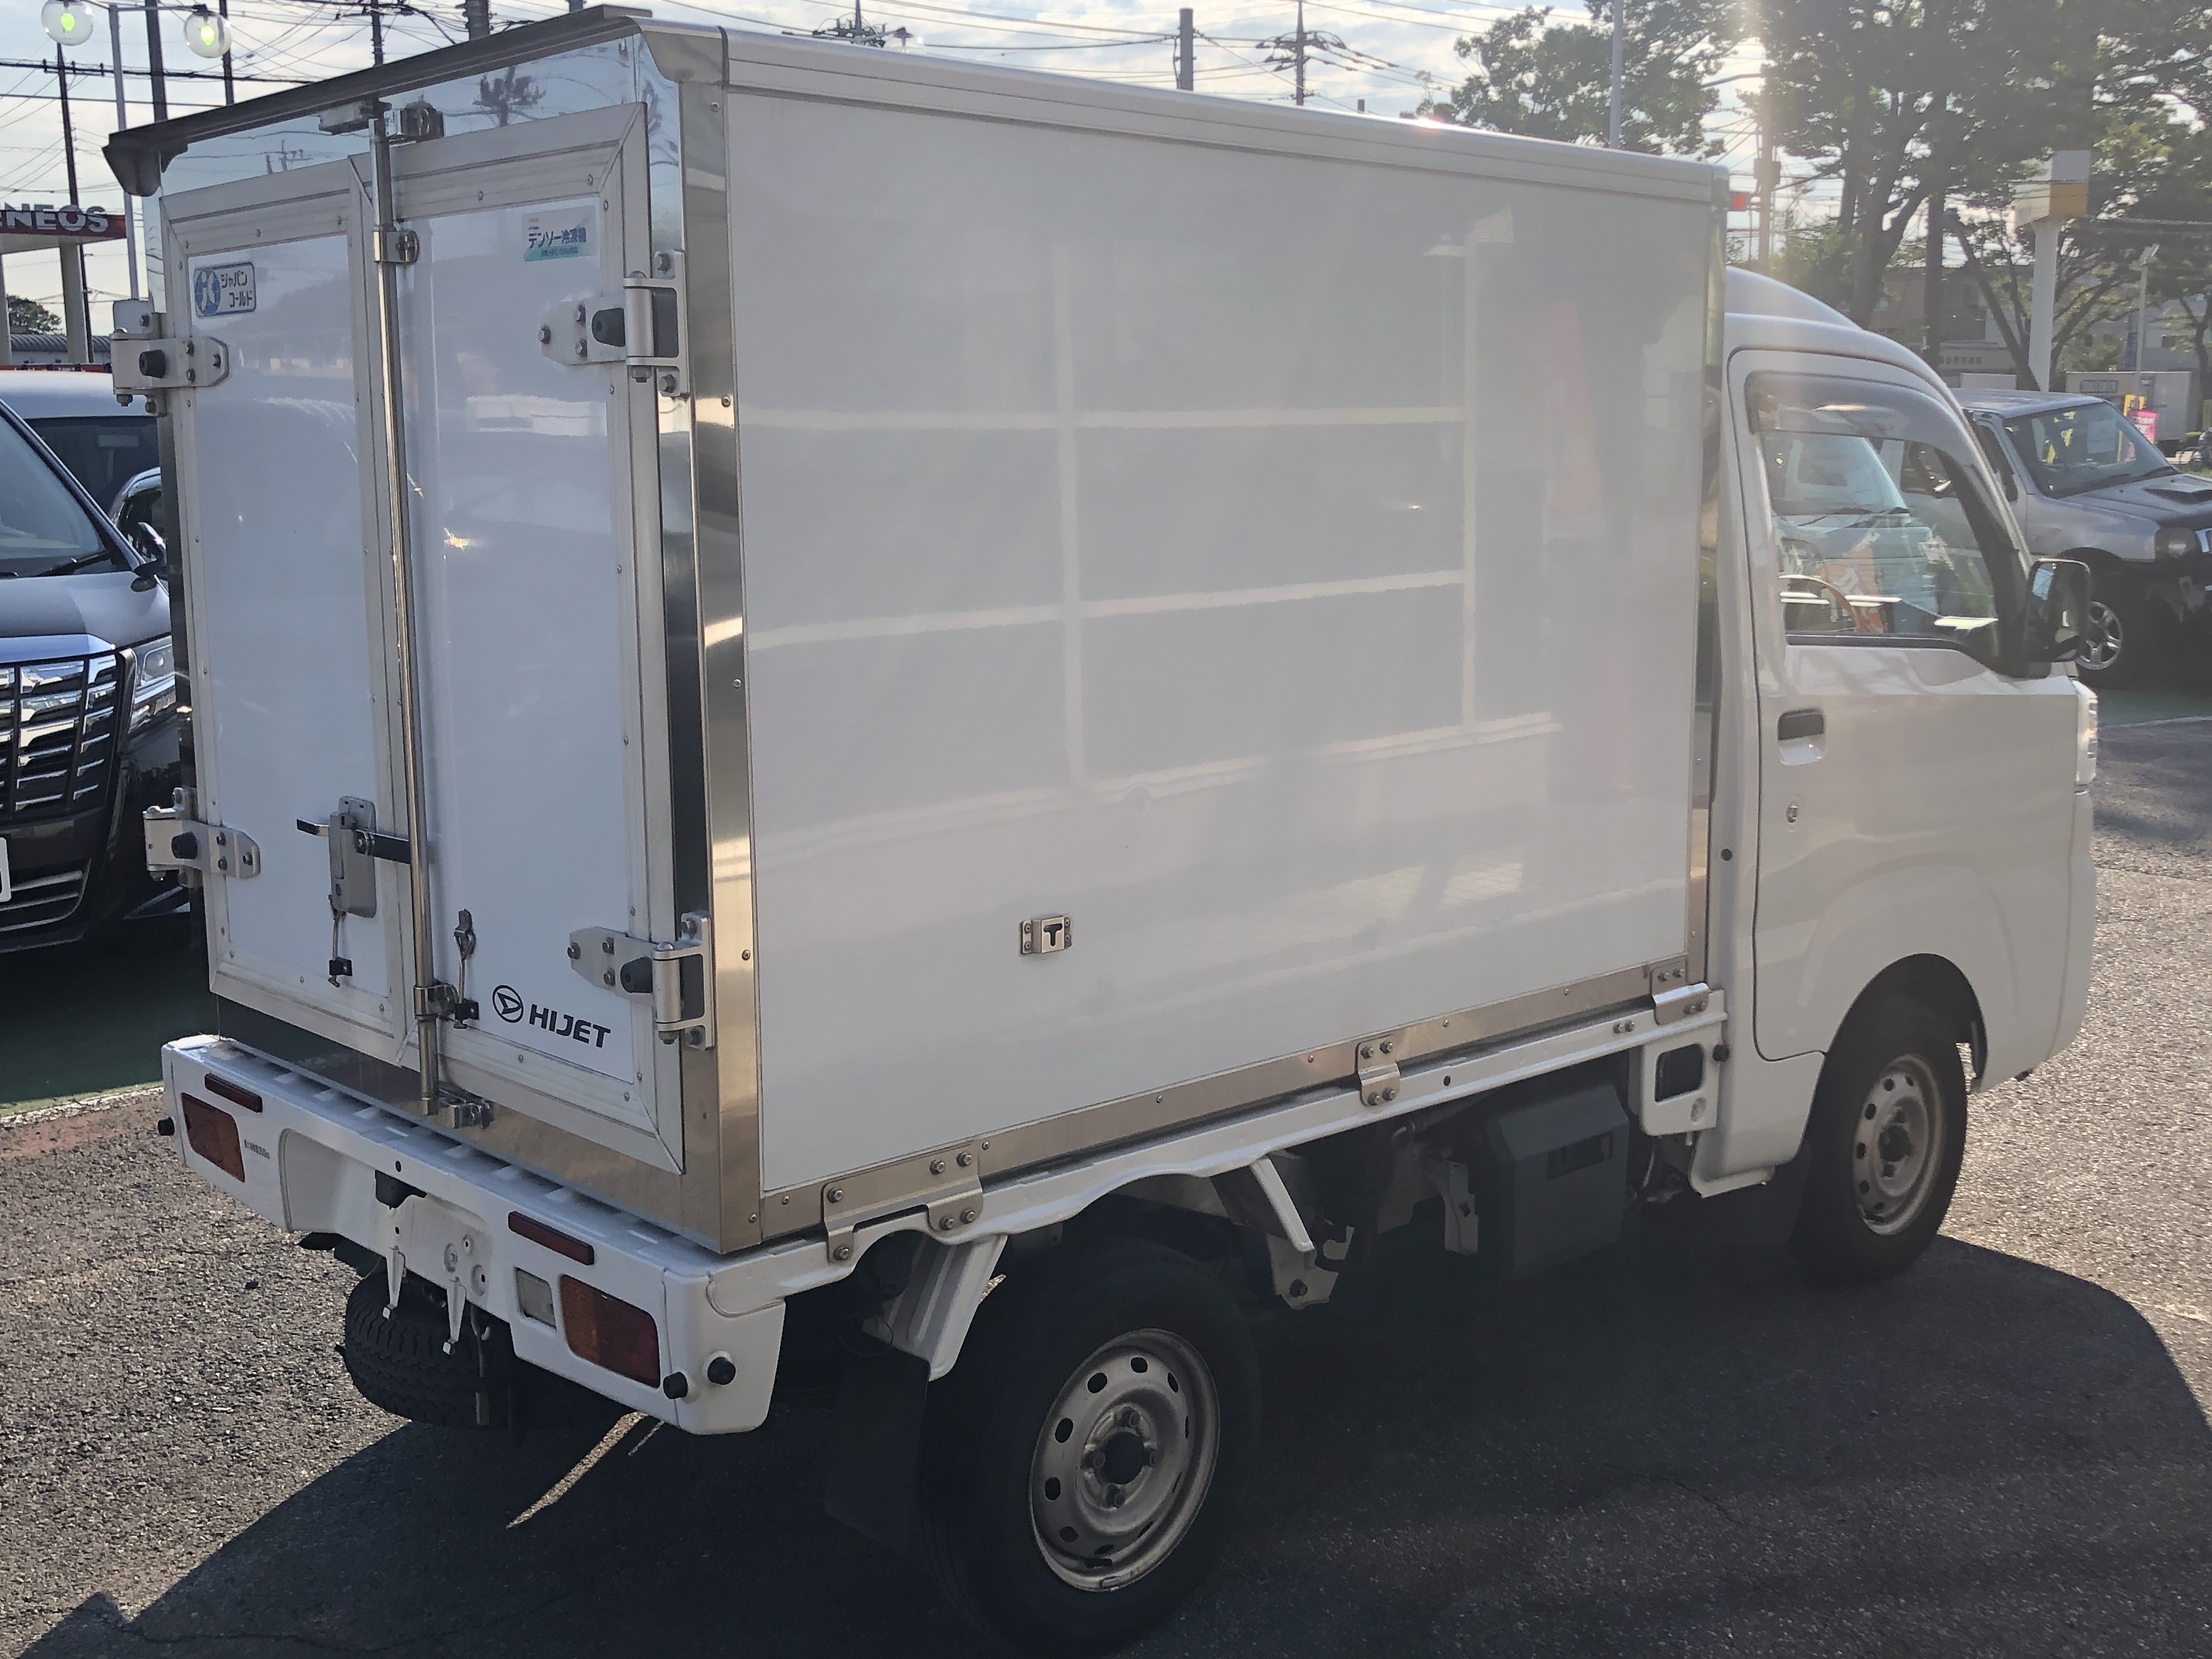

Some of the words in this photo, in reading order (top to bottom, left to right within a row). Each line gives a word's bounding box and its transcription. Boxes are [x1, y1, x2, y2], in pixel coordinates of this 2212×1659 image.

[0, 202, 109, 233] NEOS
[221, 270, 247, 289] ジャパン
[229, 290, 252, 308] コールド
[529, 1003, 611, 1048] HIJET
